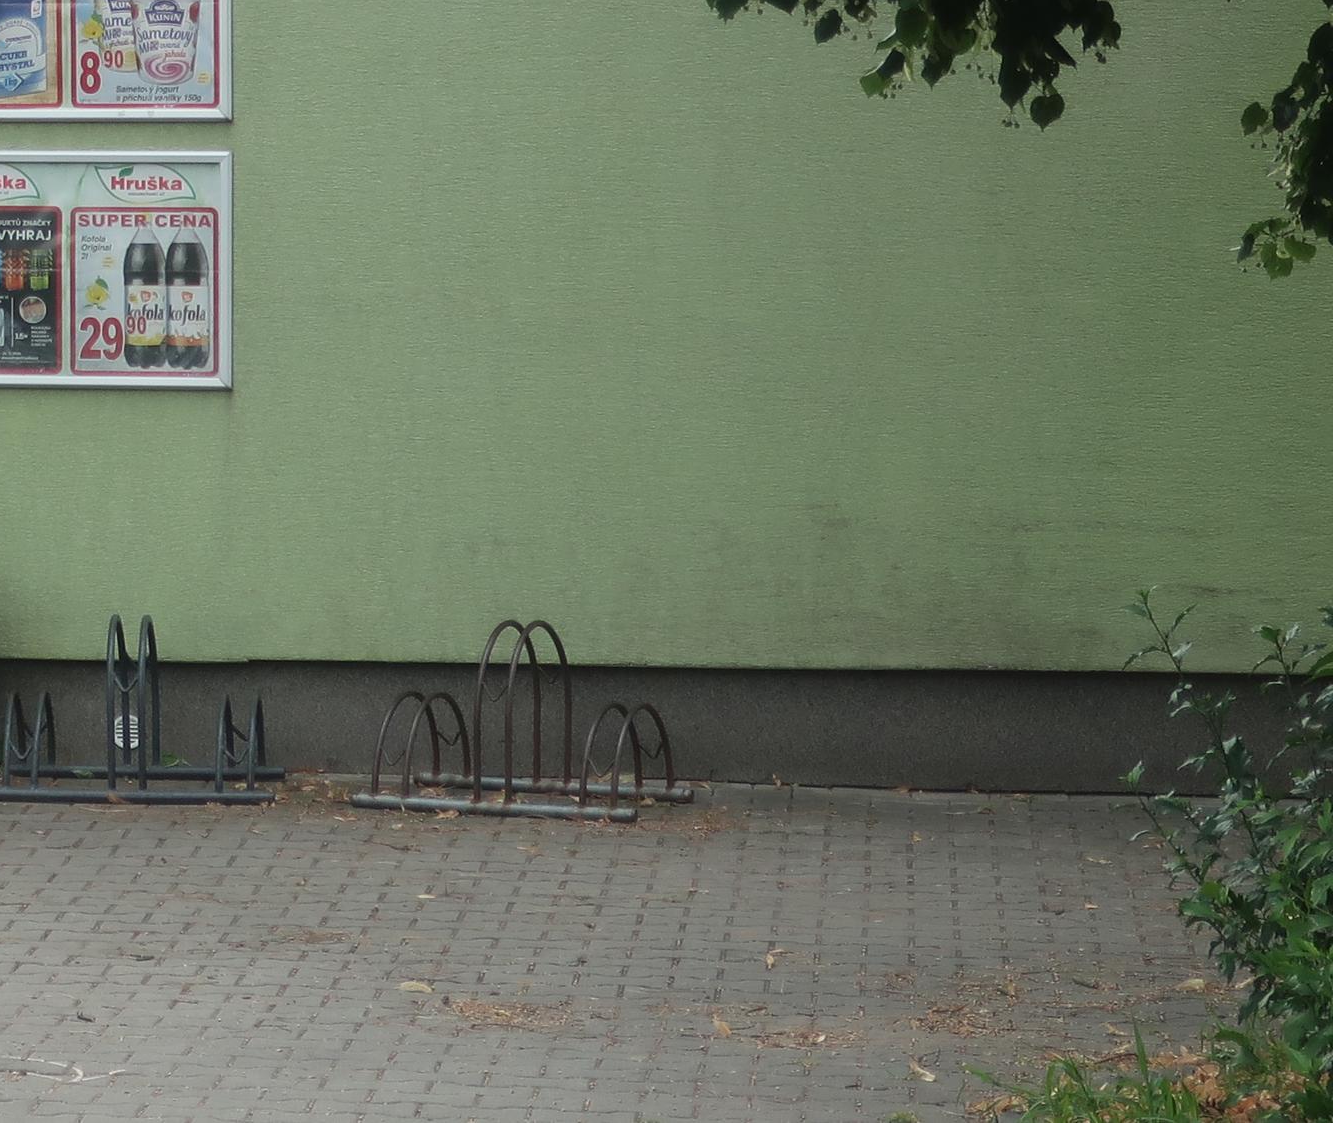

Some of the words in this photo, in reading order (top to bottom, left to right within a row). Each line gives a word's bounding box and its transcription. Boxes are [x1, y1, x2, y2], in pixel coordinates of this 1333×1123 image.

[111, 1, 132, 10] KUN
[80, 52, 101, 94] 8
[104, 51, 123, 68] 90
[110, 175, 182, 190] Hruška
[78, 215, 148, 227] SUPER
[155, 215, 211, 227] CENA
[169, 304, 206, 326] kofola
[80, 317, 123, 360] 29
[127, 316, 146, 334] 90
